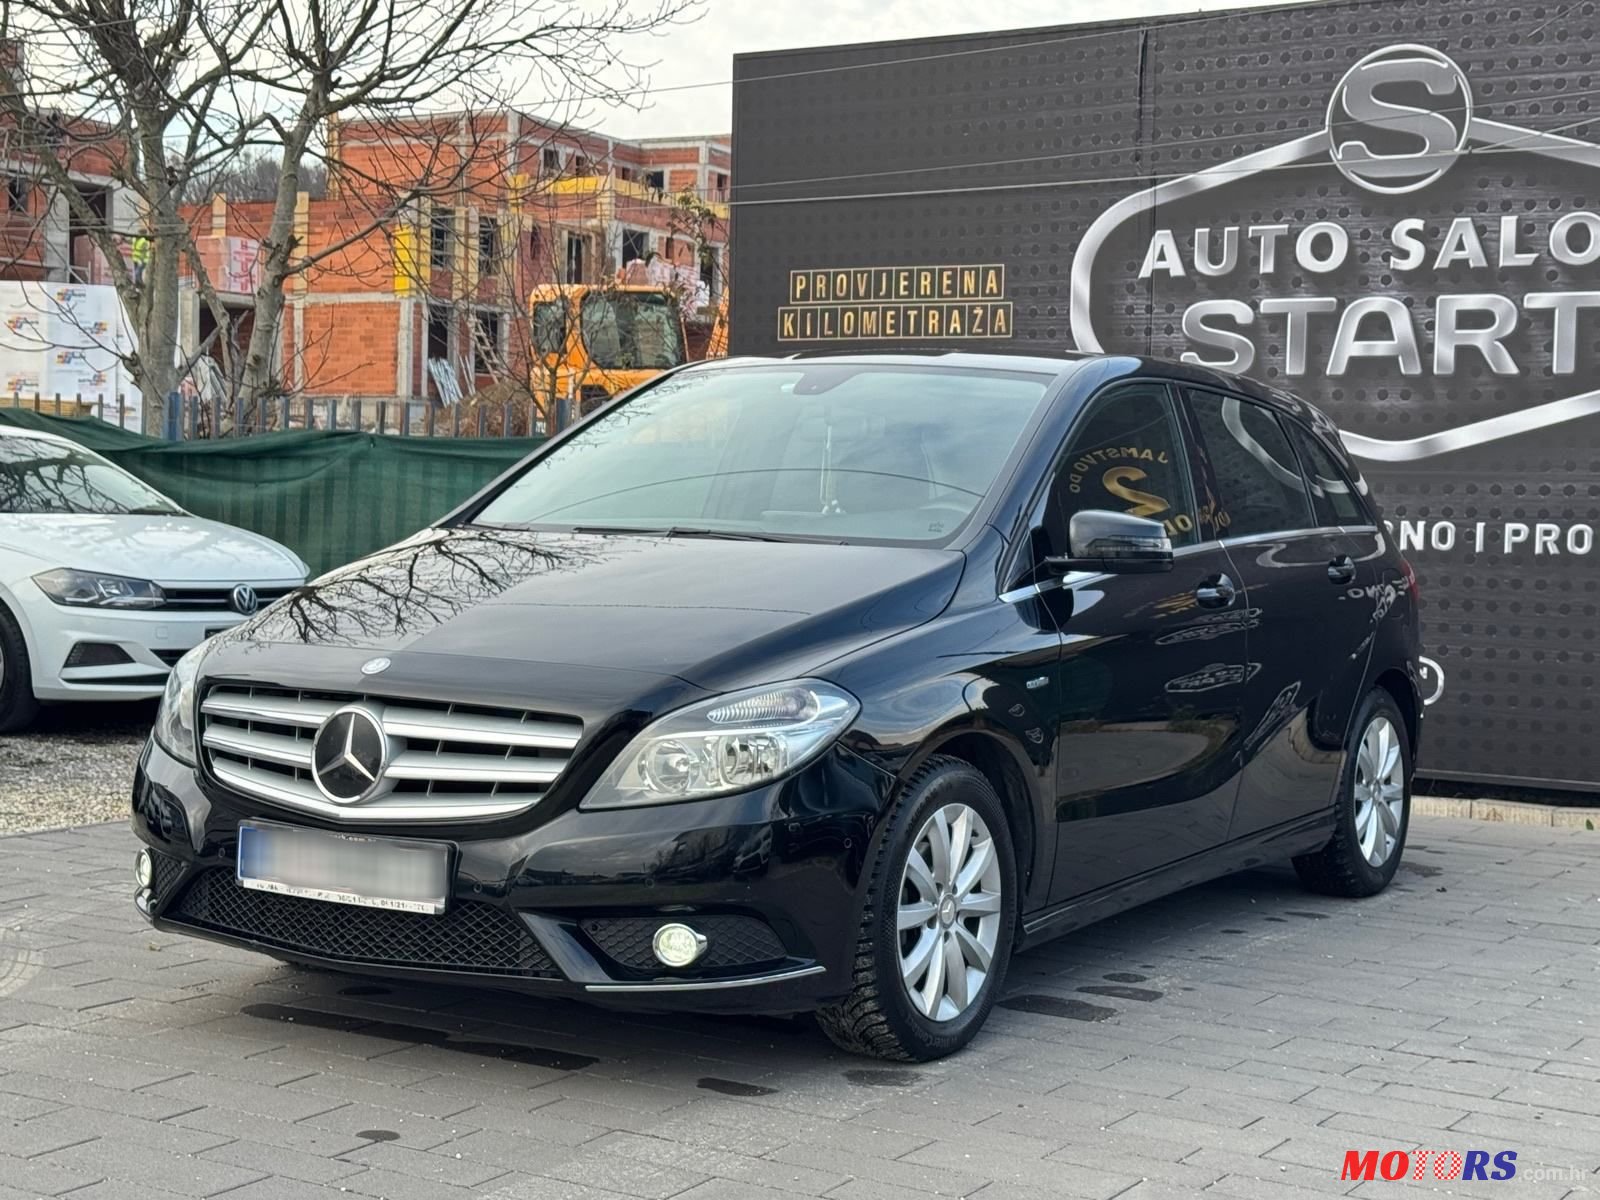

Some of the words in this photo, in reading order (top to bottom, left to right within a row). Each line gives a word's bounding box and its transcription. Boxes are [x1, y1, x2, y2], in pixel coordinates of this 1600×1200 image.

[1137, 221, 1350, 279] AUTO
[1390, 211, 1600, 271] SALO
[795, 269, 999, 299] PROVJERENA
[783, 306, 1008, 337] KILOMETRAŽA
[1180, 291, 1600, 376] START
[1383, 520, 1457, 551] NO
[1475, 522, 1486, 554] I
[1504, 522, 1594, 555] PRO
